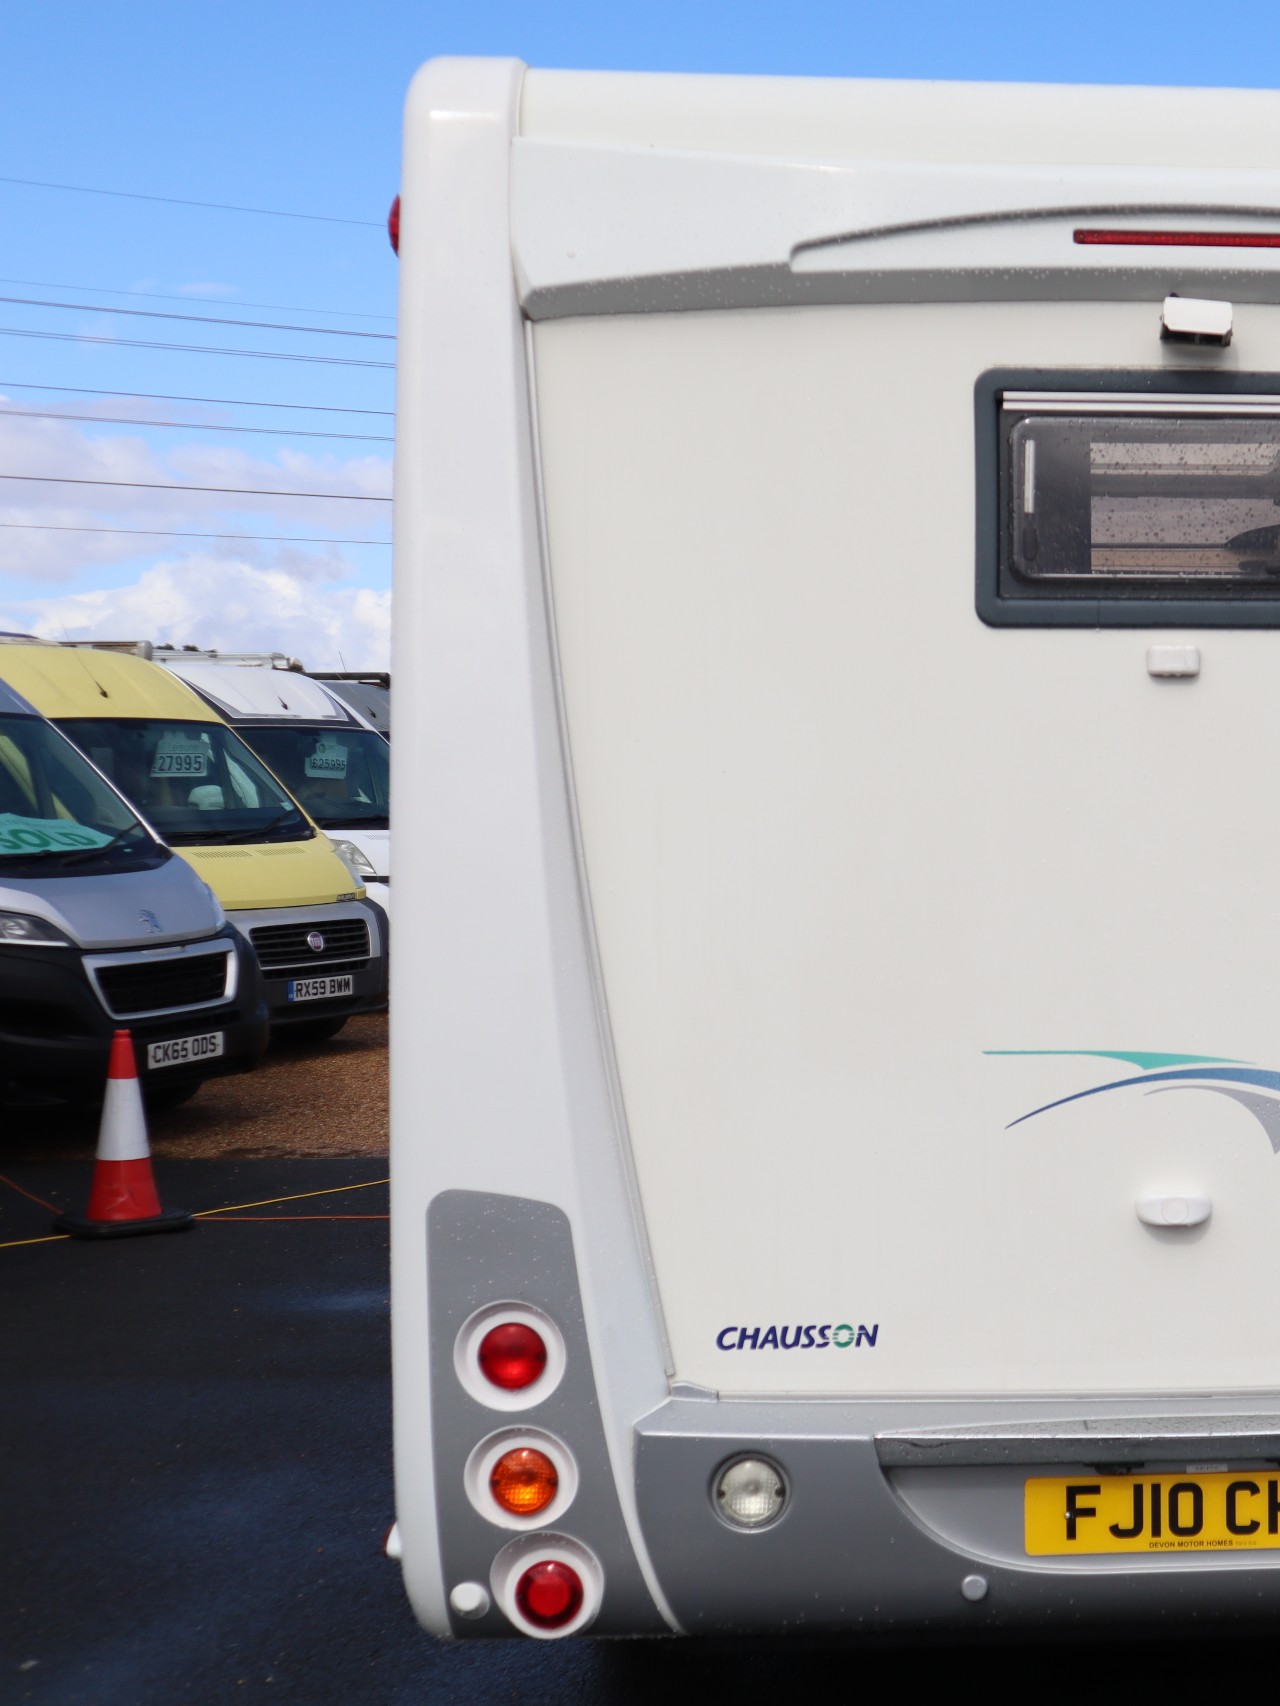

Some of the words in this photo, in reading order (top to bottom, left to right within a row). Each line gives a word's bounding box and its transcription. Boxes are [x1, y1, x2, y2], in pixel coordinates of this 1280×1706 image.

[153, 755, 202, 771] 27995
[295, 980, 326, 998] RX59
[329, 977, 351, 994] BWM
[154, 1040, 188, 1063] CK65
[716, 1324, 879, 1351] CHAUSSON
